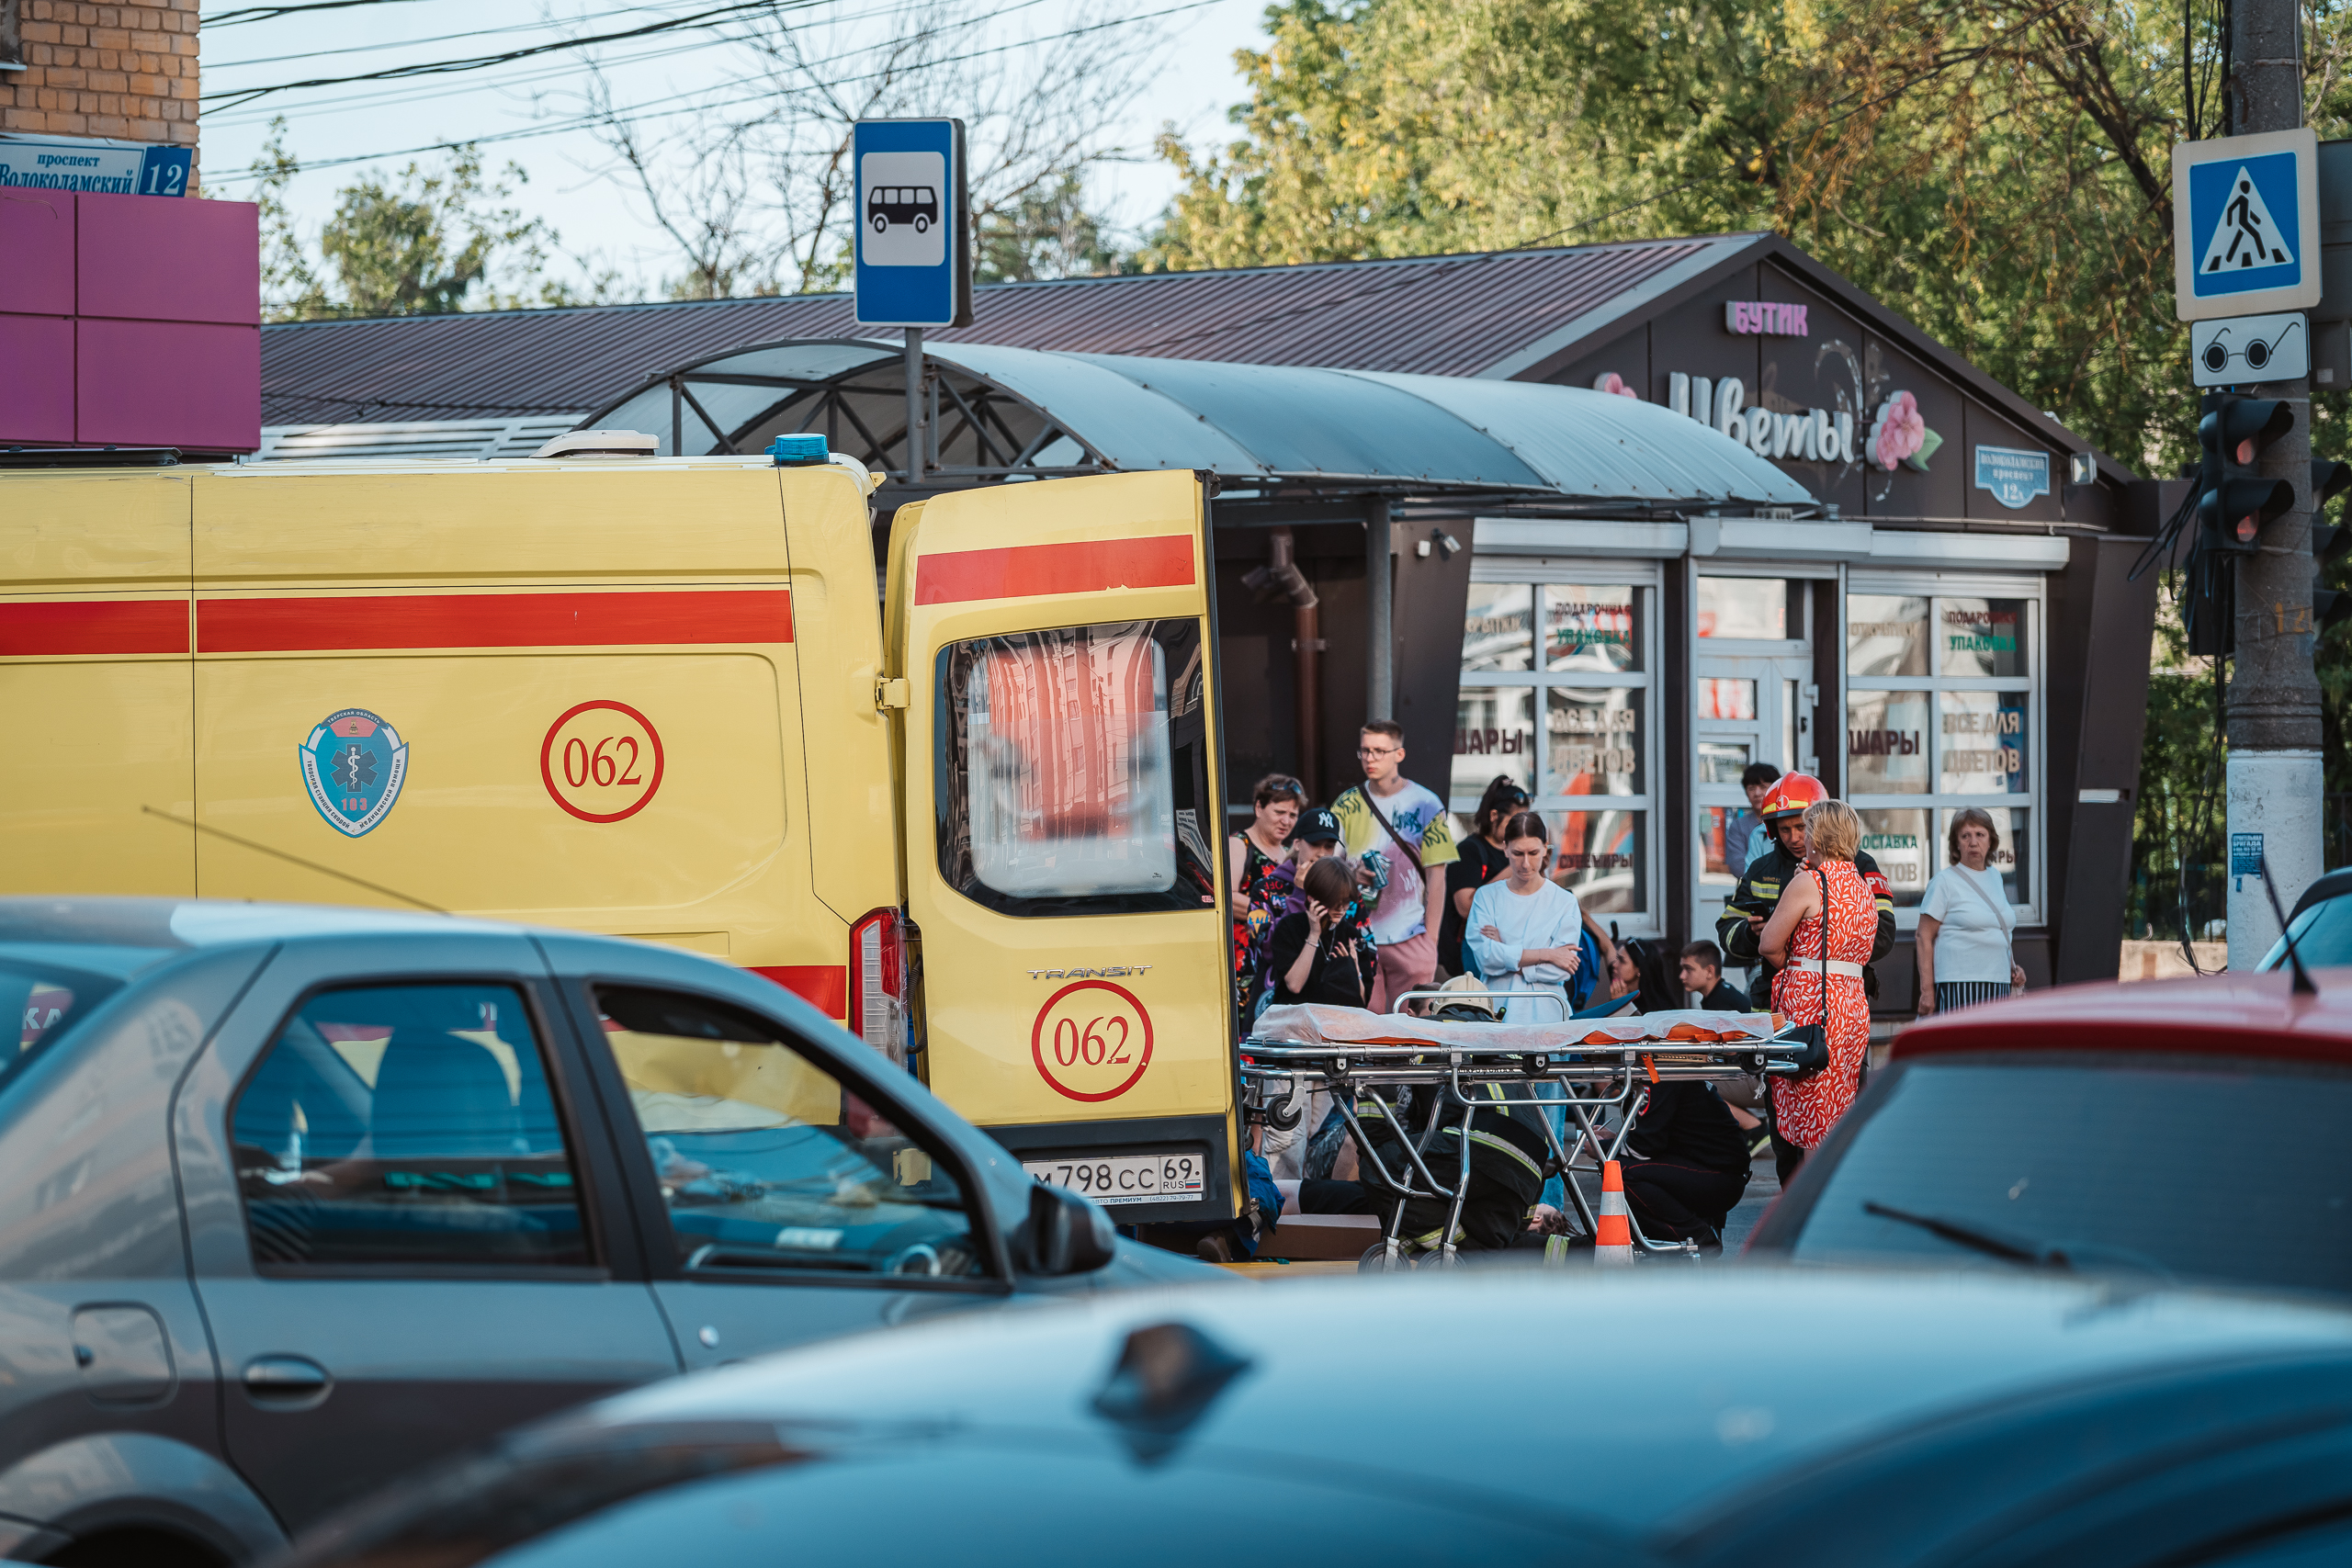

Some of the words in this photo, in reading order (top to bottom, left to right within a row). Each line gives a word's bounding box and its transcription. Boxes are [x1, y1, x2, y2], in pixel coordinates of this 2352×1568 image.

[37, 153, 100, 168] проспект
[0, 164, 134, 194] Волоколамский
[145, 163, 183, 195] 12
[1733, 301, 1808, 336] БУТИК
[1669, 372, 1854, 463] Цветы
[327, 710, 355, 724] ТВЕРСКАЯ
[356, 710, 380, 724] ОБЛАСТЬ
[1553, 709, 1591, 733] ВСЕ
[1595, 709, 1635, 738] ДЛЯ
[1946, 713, 1979, 734] ВСЕ
[1984, 712, 2020, 737] ДЛЯ
[1849, 730, 1920, 755] ШАРЫ
[563, 736, 642, 787] 062
[1947, 749, 2020, 776] ЦВЕТОВ
[341, 797, 368, 811] 103
[1026, 964, 1153, 980] TRANSIT
[1053, 1015, 1132, 1066] 062
[1164, 1158, 1193, 1180] 69
[1162, 1179, 1185, 1190] RUS
[1110, 1196, 1142, 1204] ПРЕМИУМ
